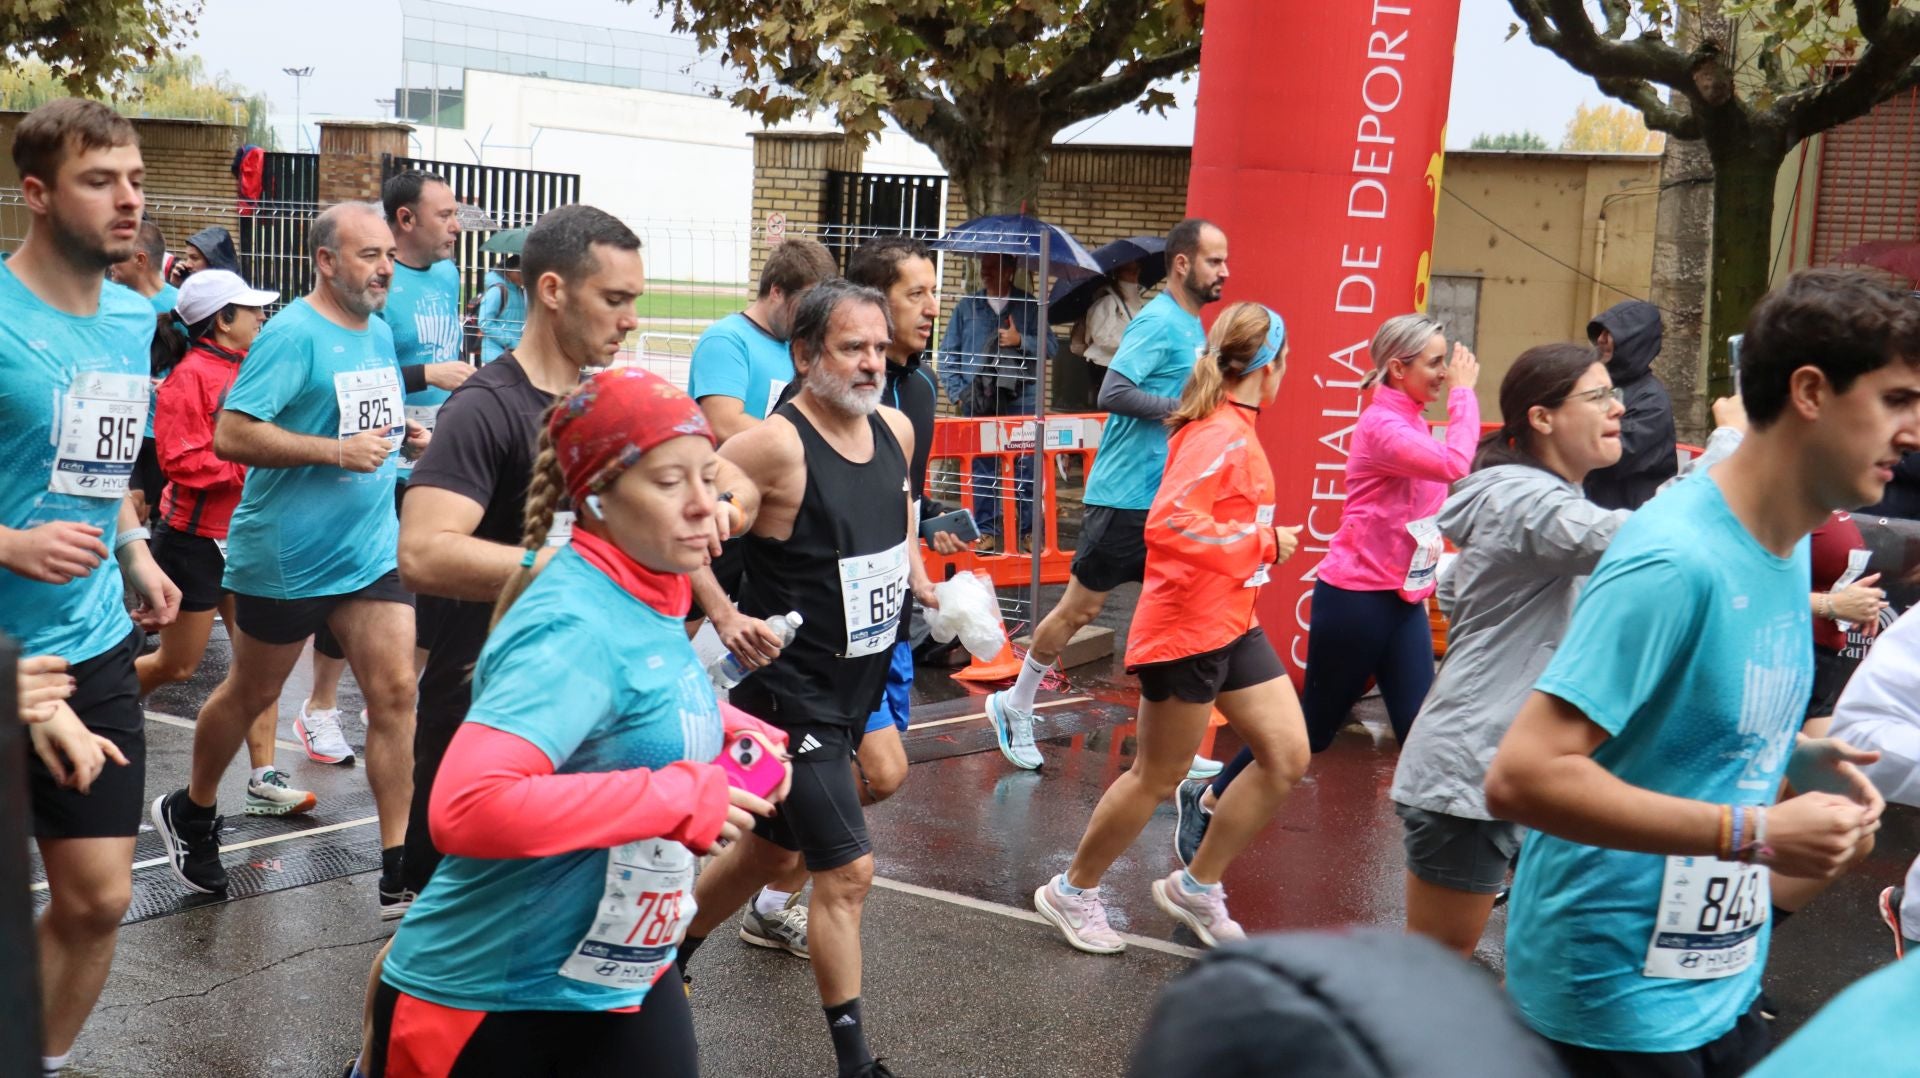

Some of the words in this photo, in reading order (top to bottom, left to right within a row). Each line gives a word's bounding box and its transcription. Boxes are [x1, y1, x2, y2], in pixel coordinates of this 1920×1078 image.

[1335, 245, 1382, 314] DE
[97, 416, 137, 460] 815
[359, 397, 392, 430] 825
[870, 576, 902, 624] 695
[624, 890, 683, 946] 788
[1697, 871, 1759, 932] 843
